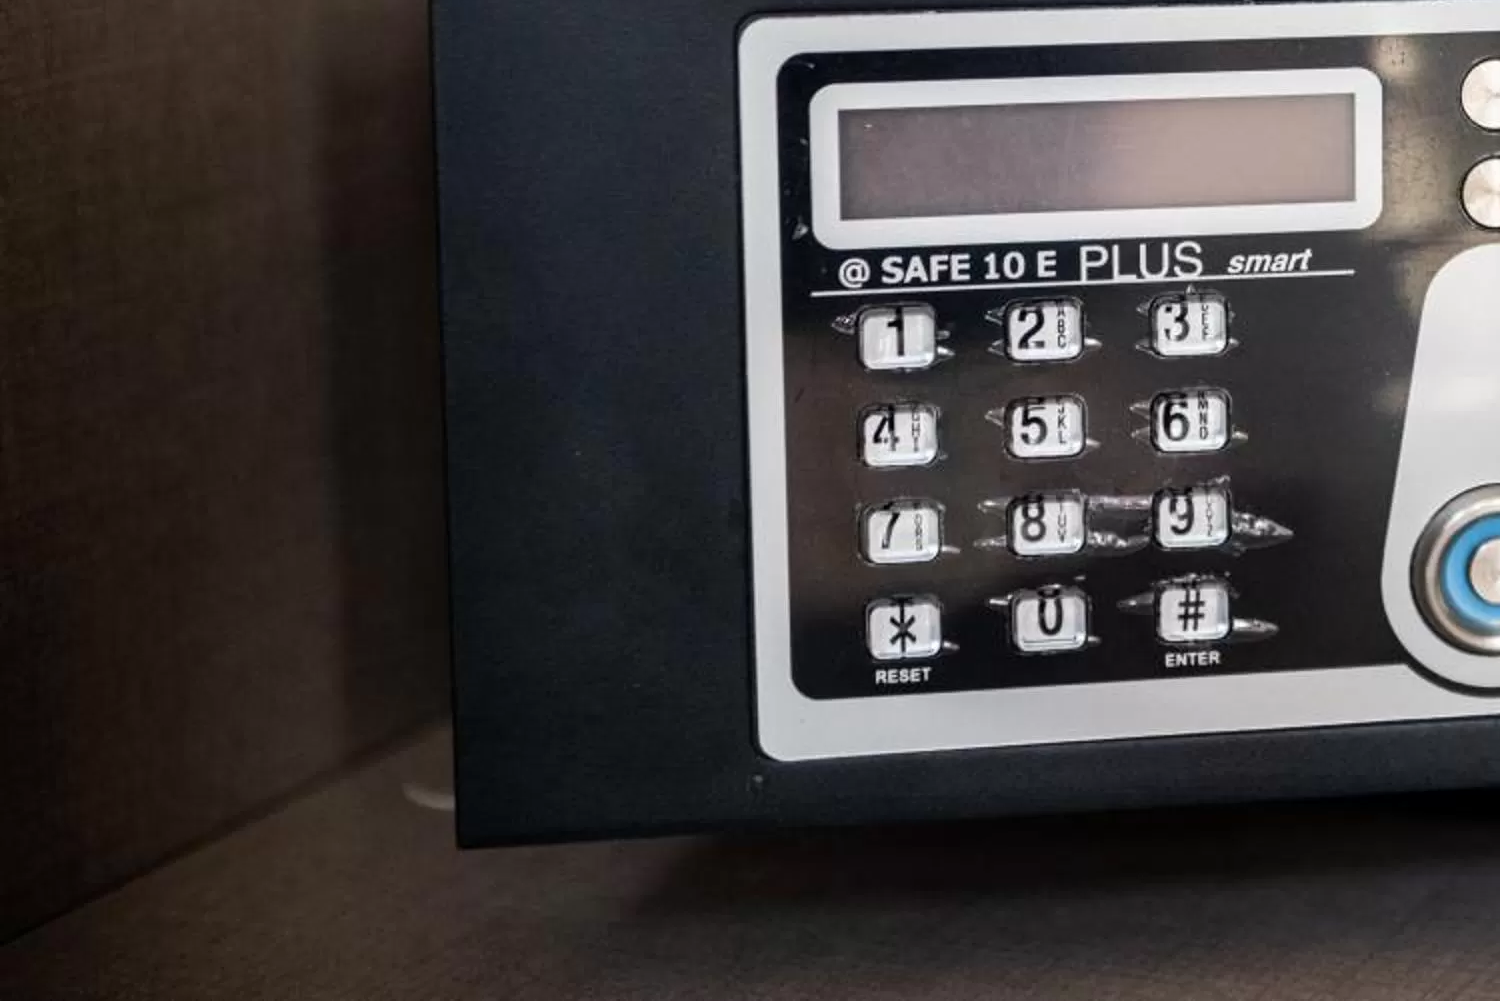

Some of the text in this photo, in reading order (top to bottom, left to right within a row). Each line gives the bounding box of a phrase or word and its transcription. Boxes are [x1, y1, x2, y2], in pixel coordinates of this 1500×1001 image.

[881, 253, 971, 284] SAFE
[984, 251, 1026, 280] 10
[1037, 250, 1057, 278] E
[1079, 240, 1204, 282] PLUS
[1227, 248, 1313, 274] smart
[887, 307, 904, 357] 1
[1018, 301, 1045, 349] 2
[1163, 296, 1190, 342] 3
[873, 403, 900, 452] 4
[1021, 397, 1047, 445] 5
[1163, 391, 1190, 442] 6
[881, 501, 901, 550] 7
[1021, 493, 1046, 543] 8
[1169, 488, 1195, 536] 9
[1177, 581, 1206, 632] #
[875, 666, 932, 684] RESET
[1164, 650, 1221, 668] ENTER
